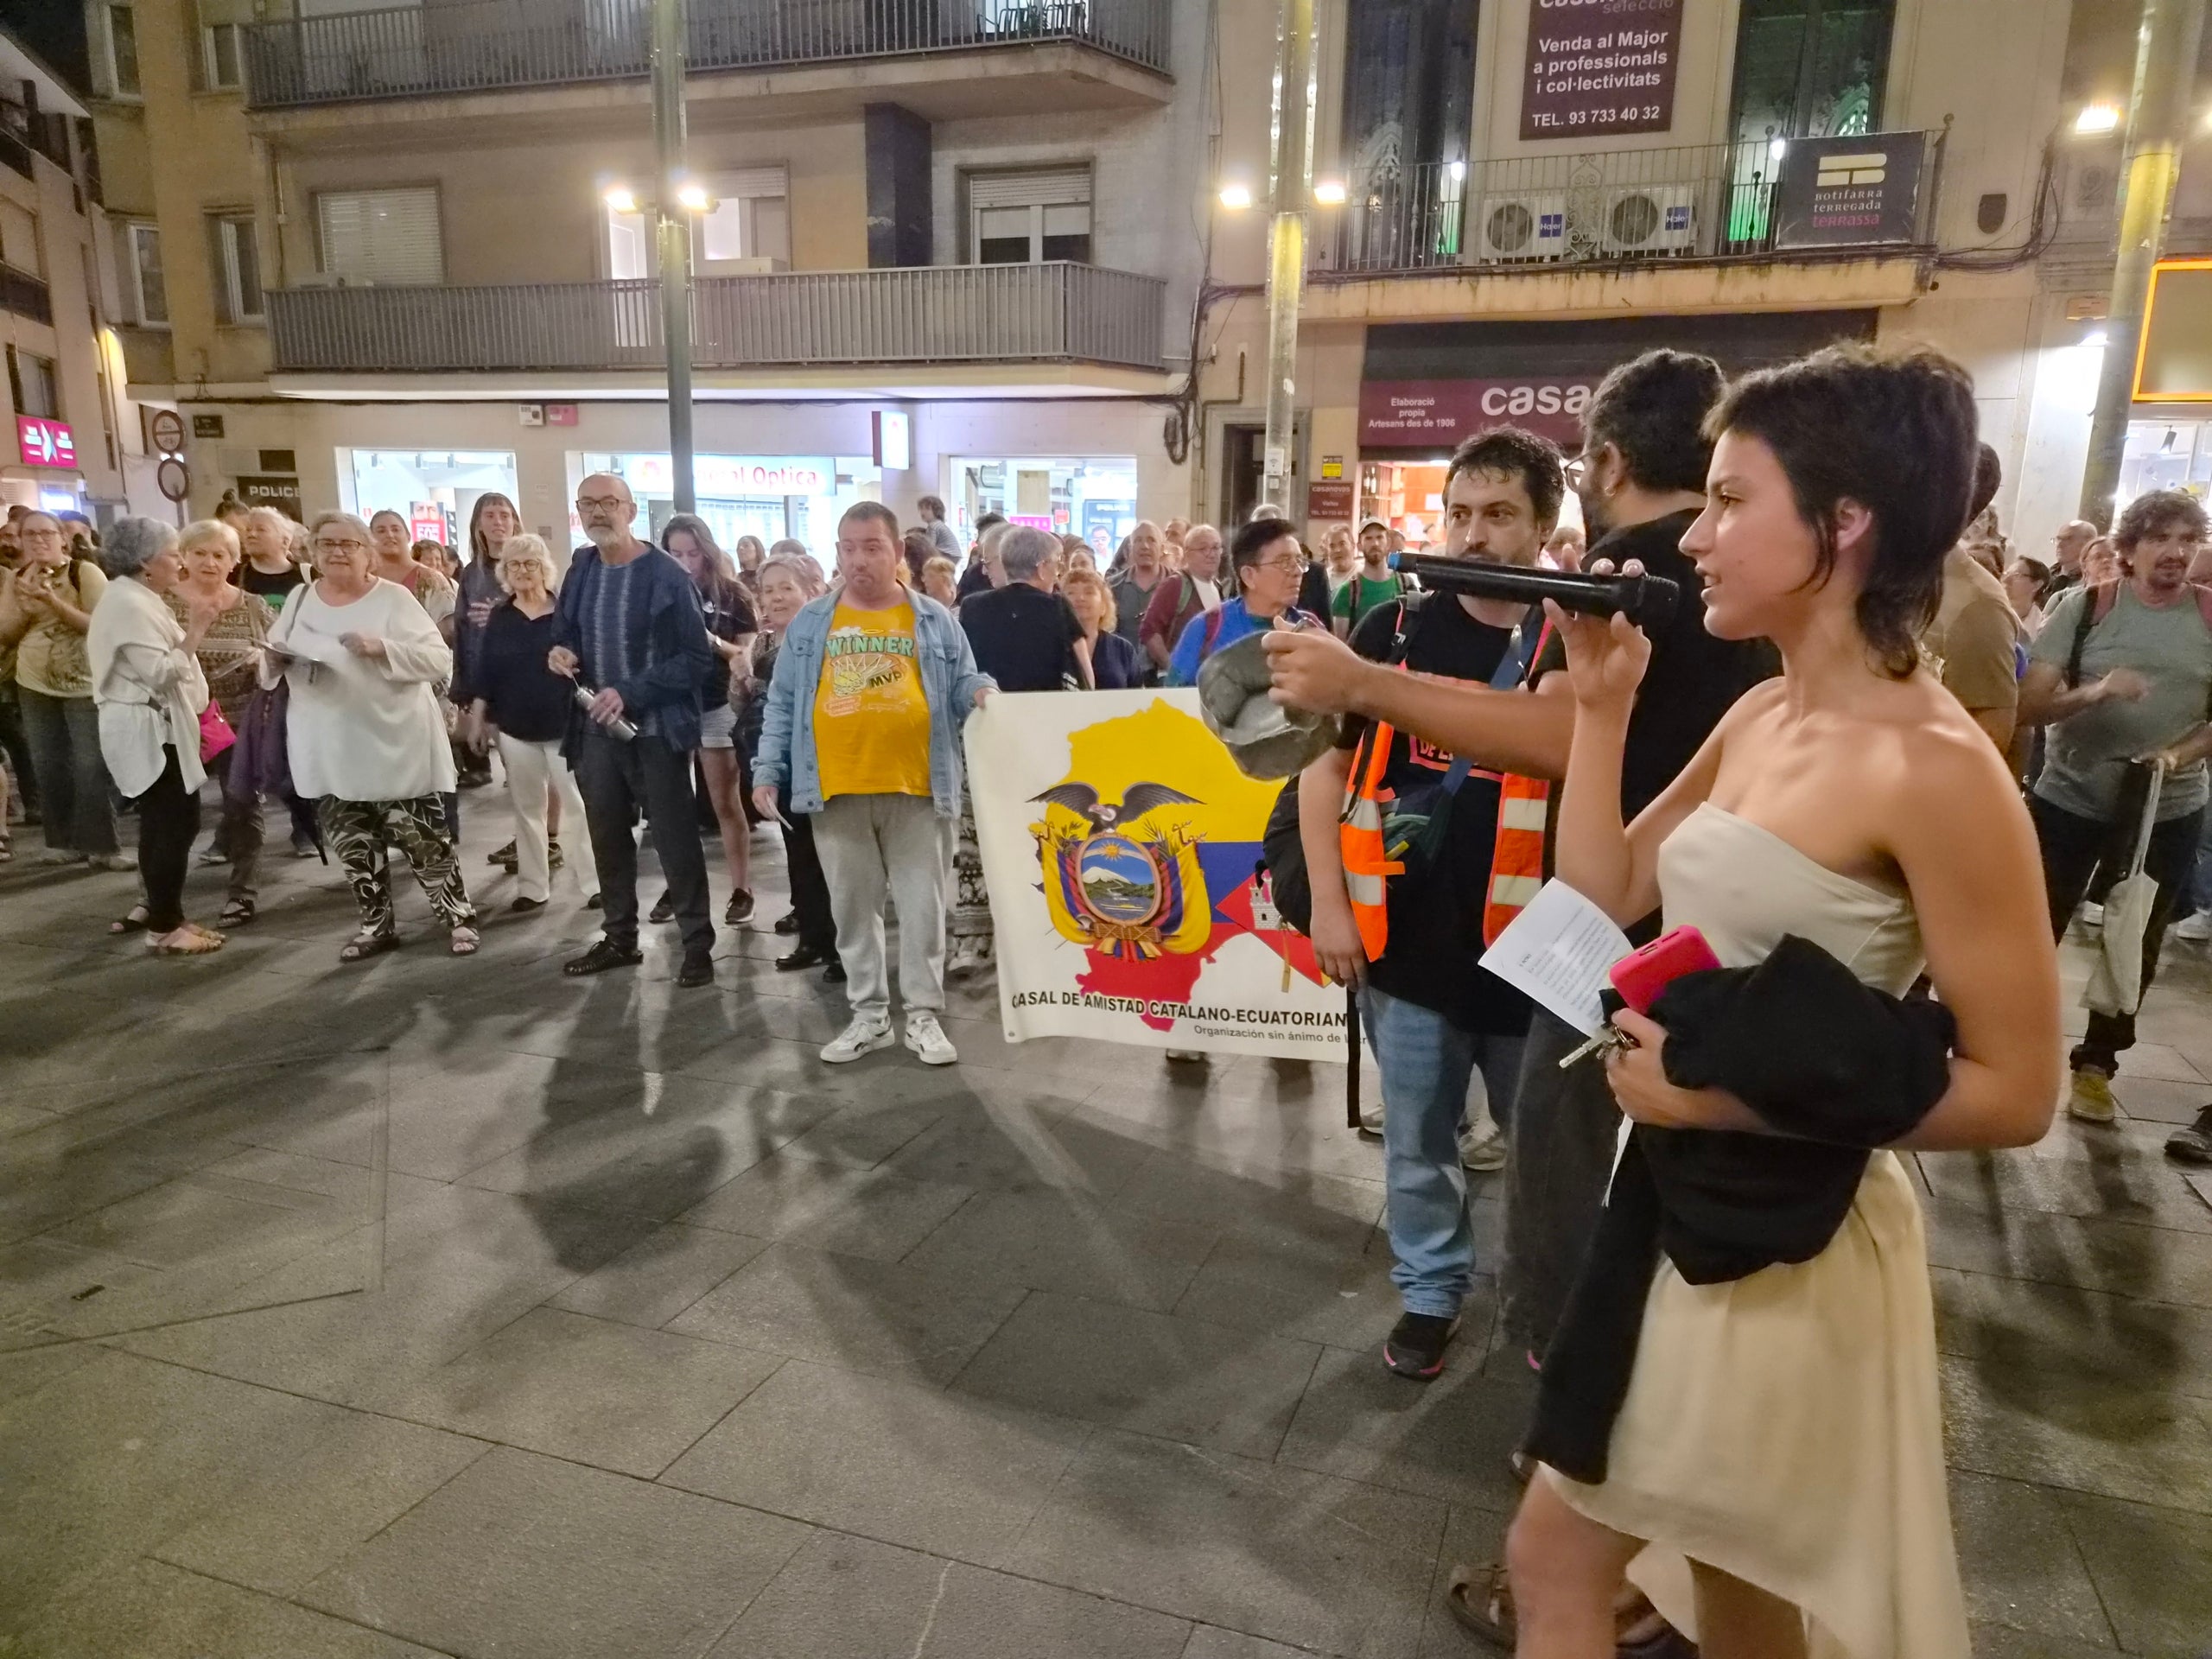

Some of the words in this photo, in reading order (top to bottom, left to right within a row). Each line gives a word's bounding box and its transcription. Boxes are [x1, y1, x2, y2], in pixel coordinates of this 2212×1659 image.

[1539, 36, 1592, 53] Venda
[1598, 34, 1613, 48] al
[1618, 30, 1669, 48] Major
[1534, 63, 1543, 74] a
[1548, 50, 1668, 76] professionals
[1537, 79, 1541, 93] i
[1547, 72, 1661, 93] col·lectivitats
[1532, 113, 1564, 127] TEL.
[1569, 111, 1586, 124] 93
[1591, 110, 1616, 123] 733
[1620, 107, 1638, 121] 40
[1642, 105, 1660, 119] 32
[1666, 213, 1688, 223] Haie
[1391, 397, 1435, 407] Elaboració
[1481, 385, 1591, 416] casa
[1369, 419, 1405, 428] Artesans
[1407, 418, 1421, 428] des
[1423, 418, 1433, 427] de
[1436, 418, 1456, 427] 1906
[1399, 409, 1426, 418] propia
[753, 467, 817, 490] Optica
[826, 636, 914, 658] WINNER
[869, 671, 903, 689] MVP
[1012, 991, 1058, 1009] CASAL
[1062, 992, 1080, 1007] DE
[1084, 994, 1145, 1014] AMISTAD
[1149, 1001, 1346, 1027] CATALANO-ECUATORIAN
[1194, 1025, 1265, 1039] Organización
[1268, 1031, 1285, 1040] sin
[1288, 1031, 1324, 1042] ánimo
[1327, 1033, 1341, 1043] de
